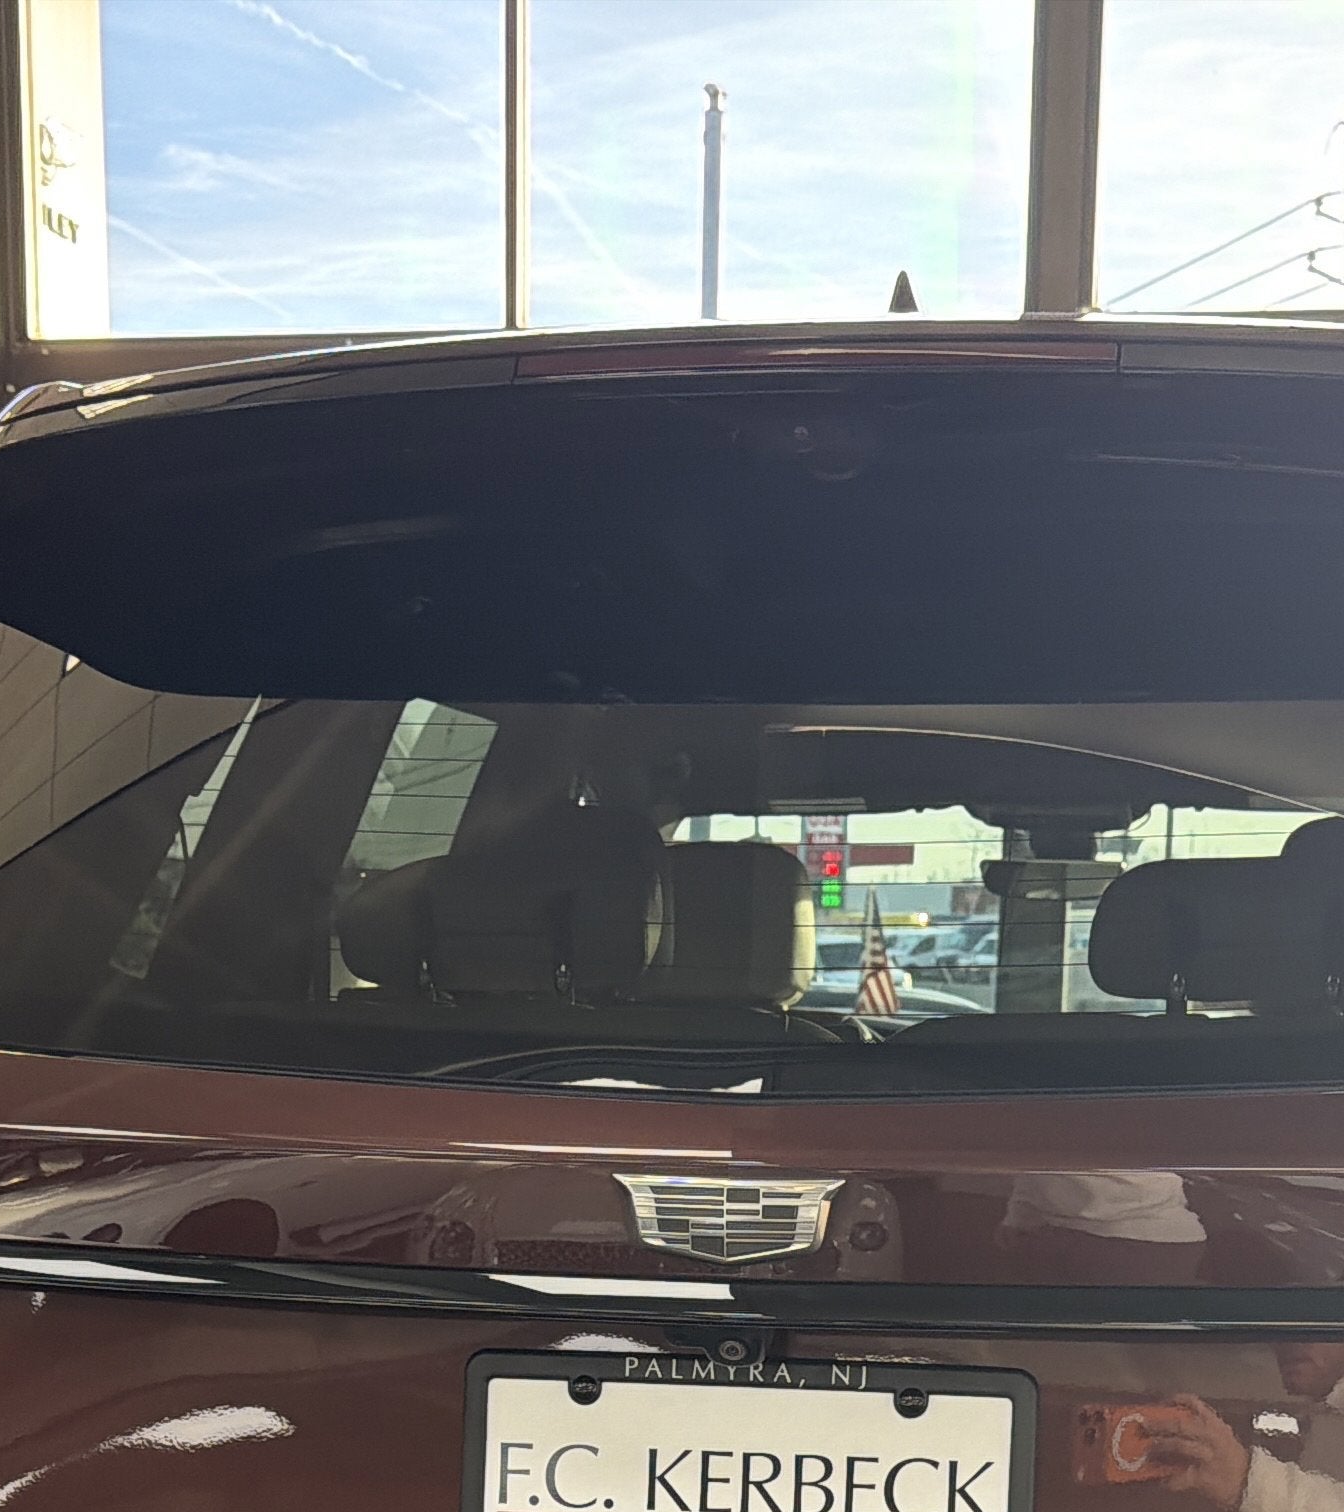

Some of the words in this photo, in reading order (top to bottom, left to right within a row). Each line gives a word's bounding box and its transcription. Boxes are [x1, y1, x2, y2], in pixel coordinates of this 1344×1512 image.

[624, 1357, 806, 1388] PALMYRA,
[831, 1365, 868, 1390] NJ
[498, 1442, 614, 1509] F.C.
